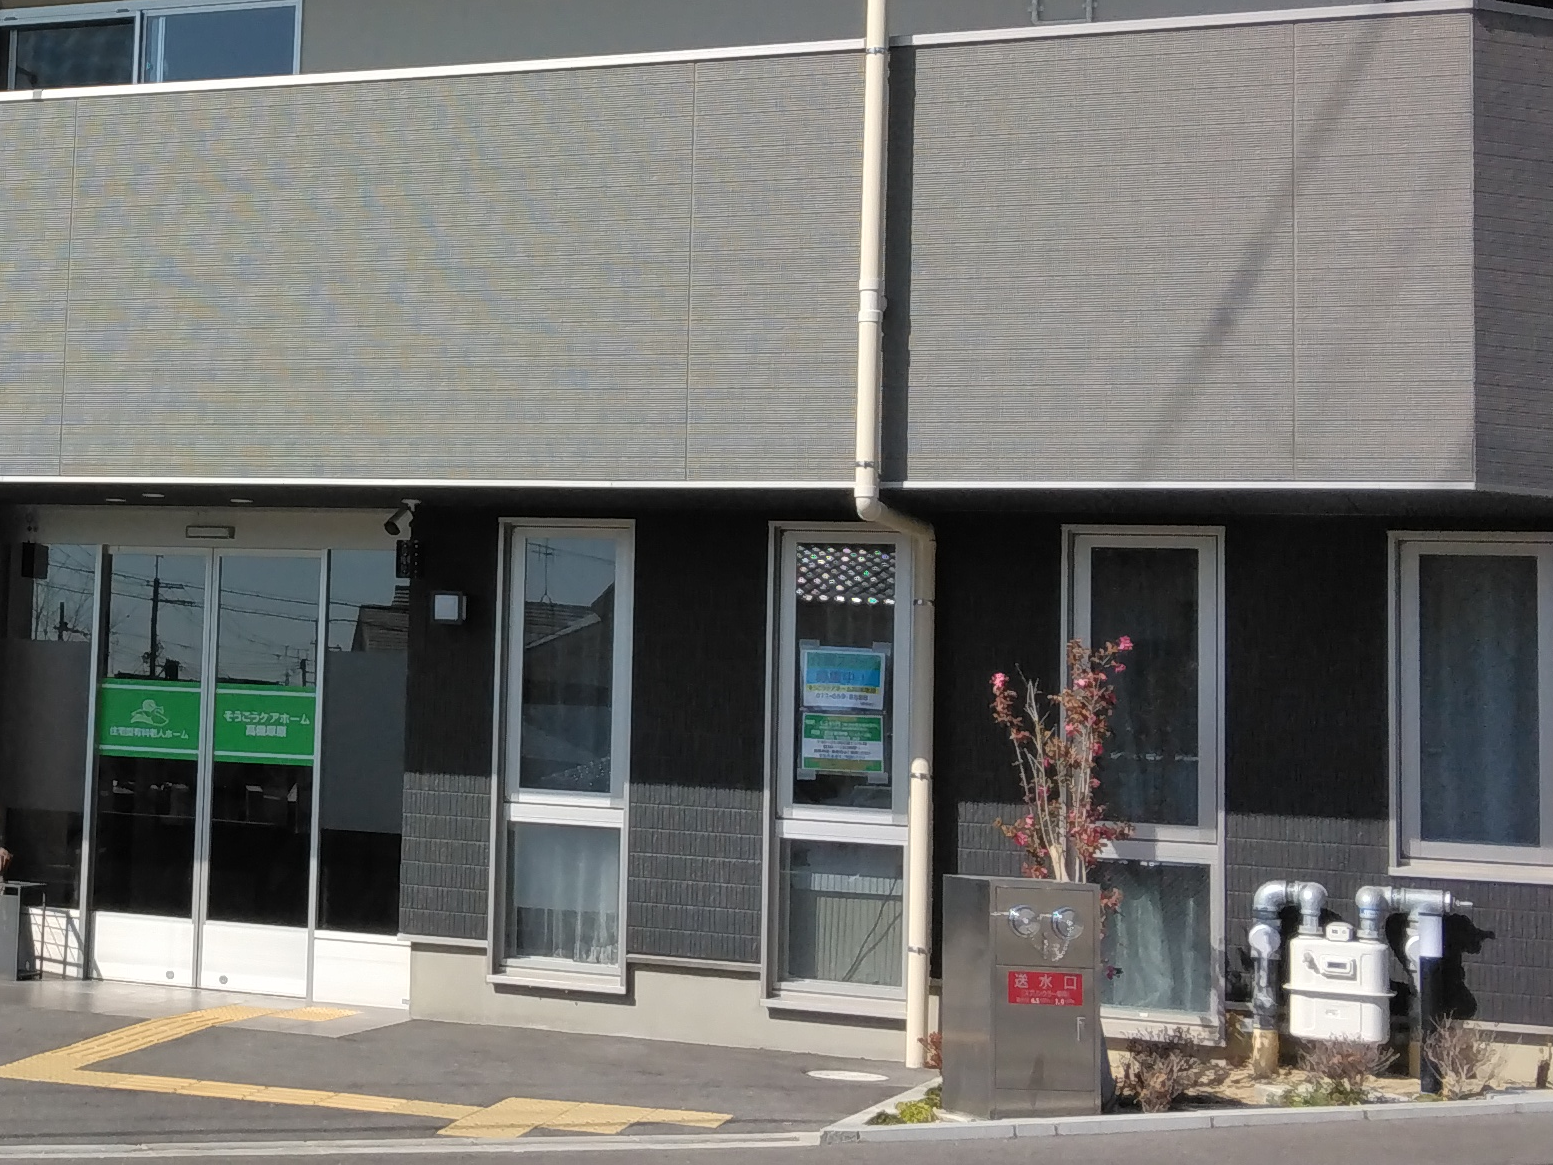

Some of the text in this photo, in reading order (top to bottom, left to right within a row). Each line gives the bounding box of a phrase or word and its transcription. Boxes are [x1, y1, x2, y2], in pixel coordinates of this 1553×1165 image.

[222, 710, 311, 724] そうこうケアホーム
[109, 725, 190, 740] 住宅型有料老人ホーム
[1014, 973, 1078, 990] 送水口
